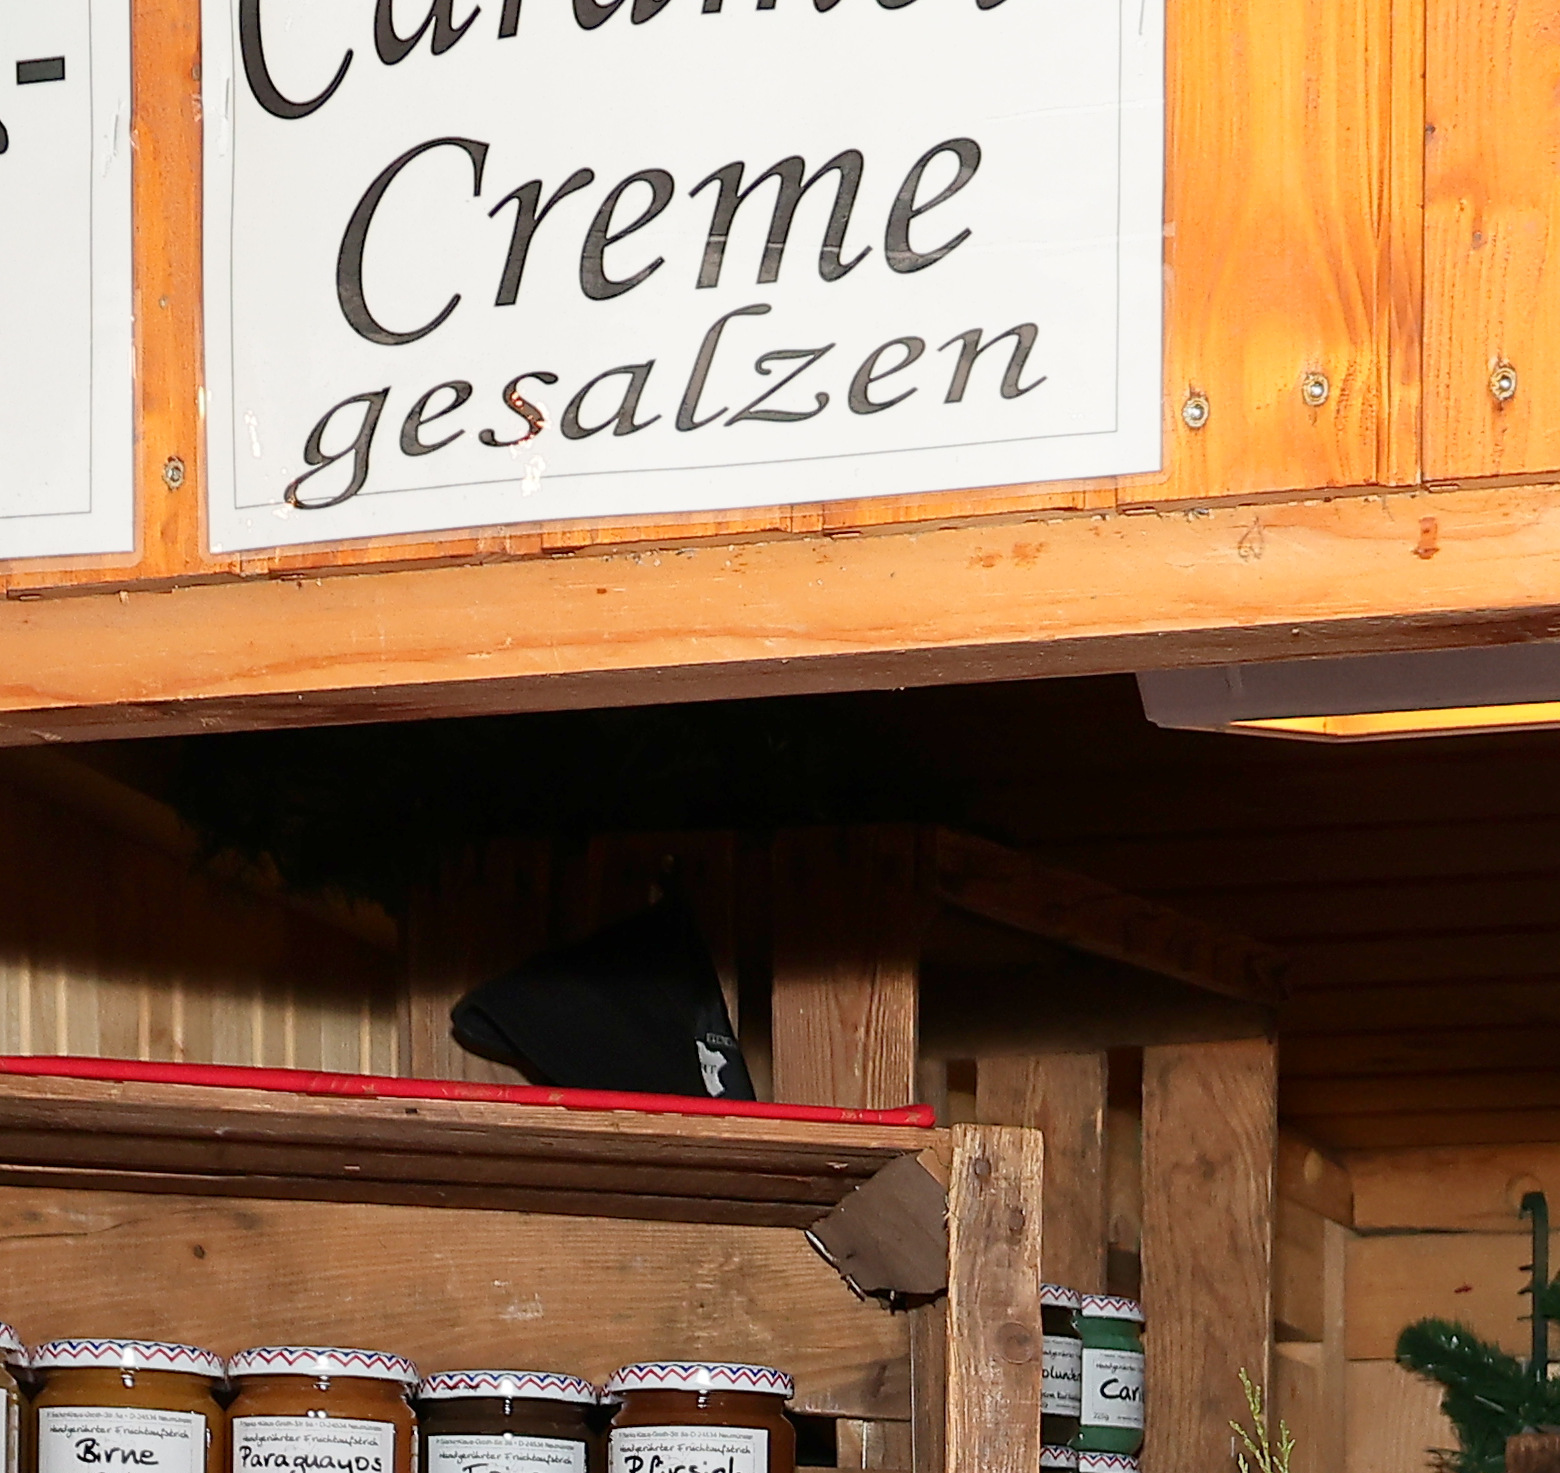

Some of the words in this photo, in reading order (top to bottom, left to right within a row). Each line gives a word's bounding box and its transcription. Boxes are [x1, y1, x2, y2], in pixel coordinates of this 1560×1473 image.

[335, 136, 984, 346] Creme
[282, 303, 1047, 511] gesalzen
[75, 1439, 160, 1467] Birne
